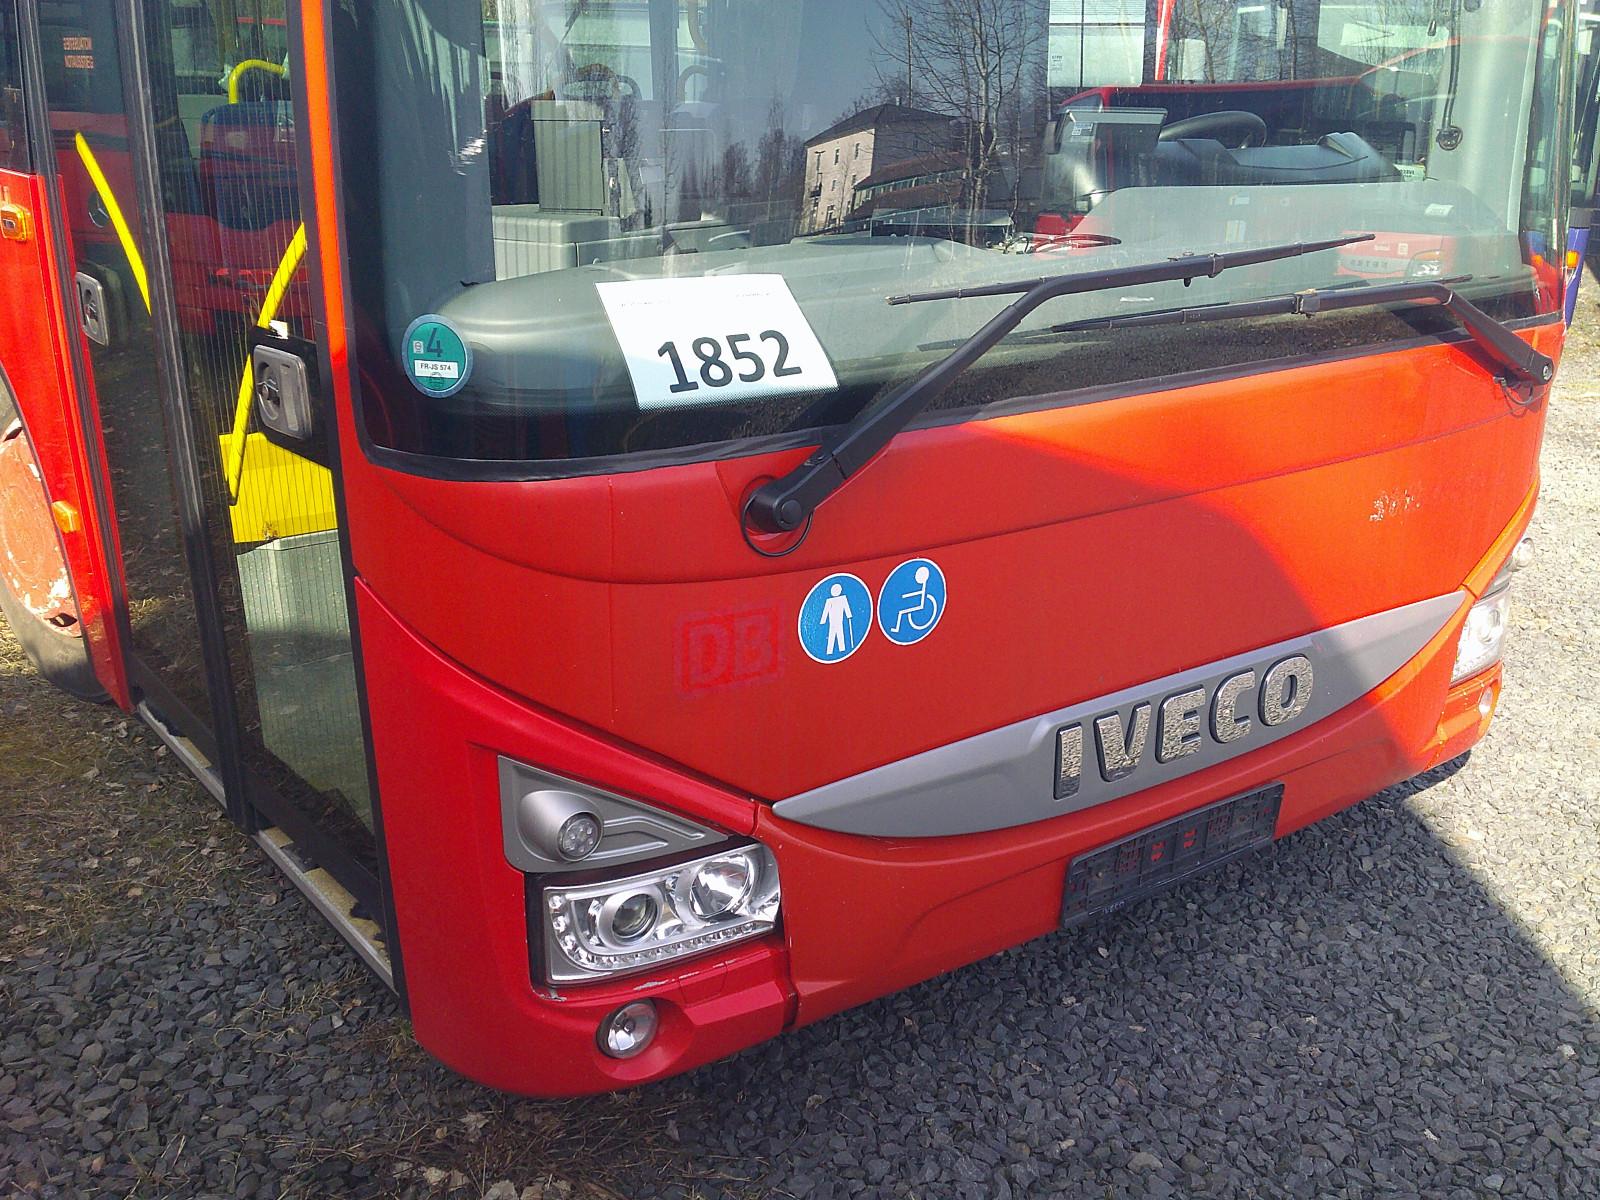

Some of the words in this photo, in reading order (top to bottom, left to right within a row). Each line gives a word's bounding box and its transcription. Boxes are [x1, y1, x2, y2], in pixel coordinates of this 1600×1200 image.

[420, 363, 439, 371] FR-JS
[427, 328, 443, 357] 4
[657, 329, 802, 393] 1852
[689, 616, 771, 687] DB
[1053, 653, 1313, 800] IVECO
